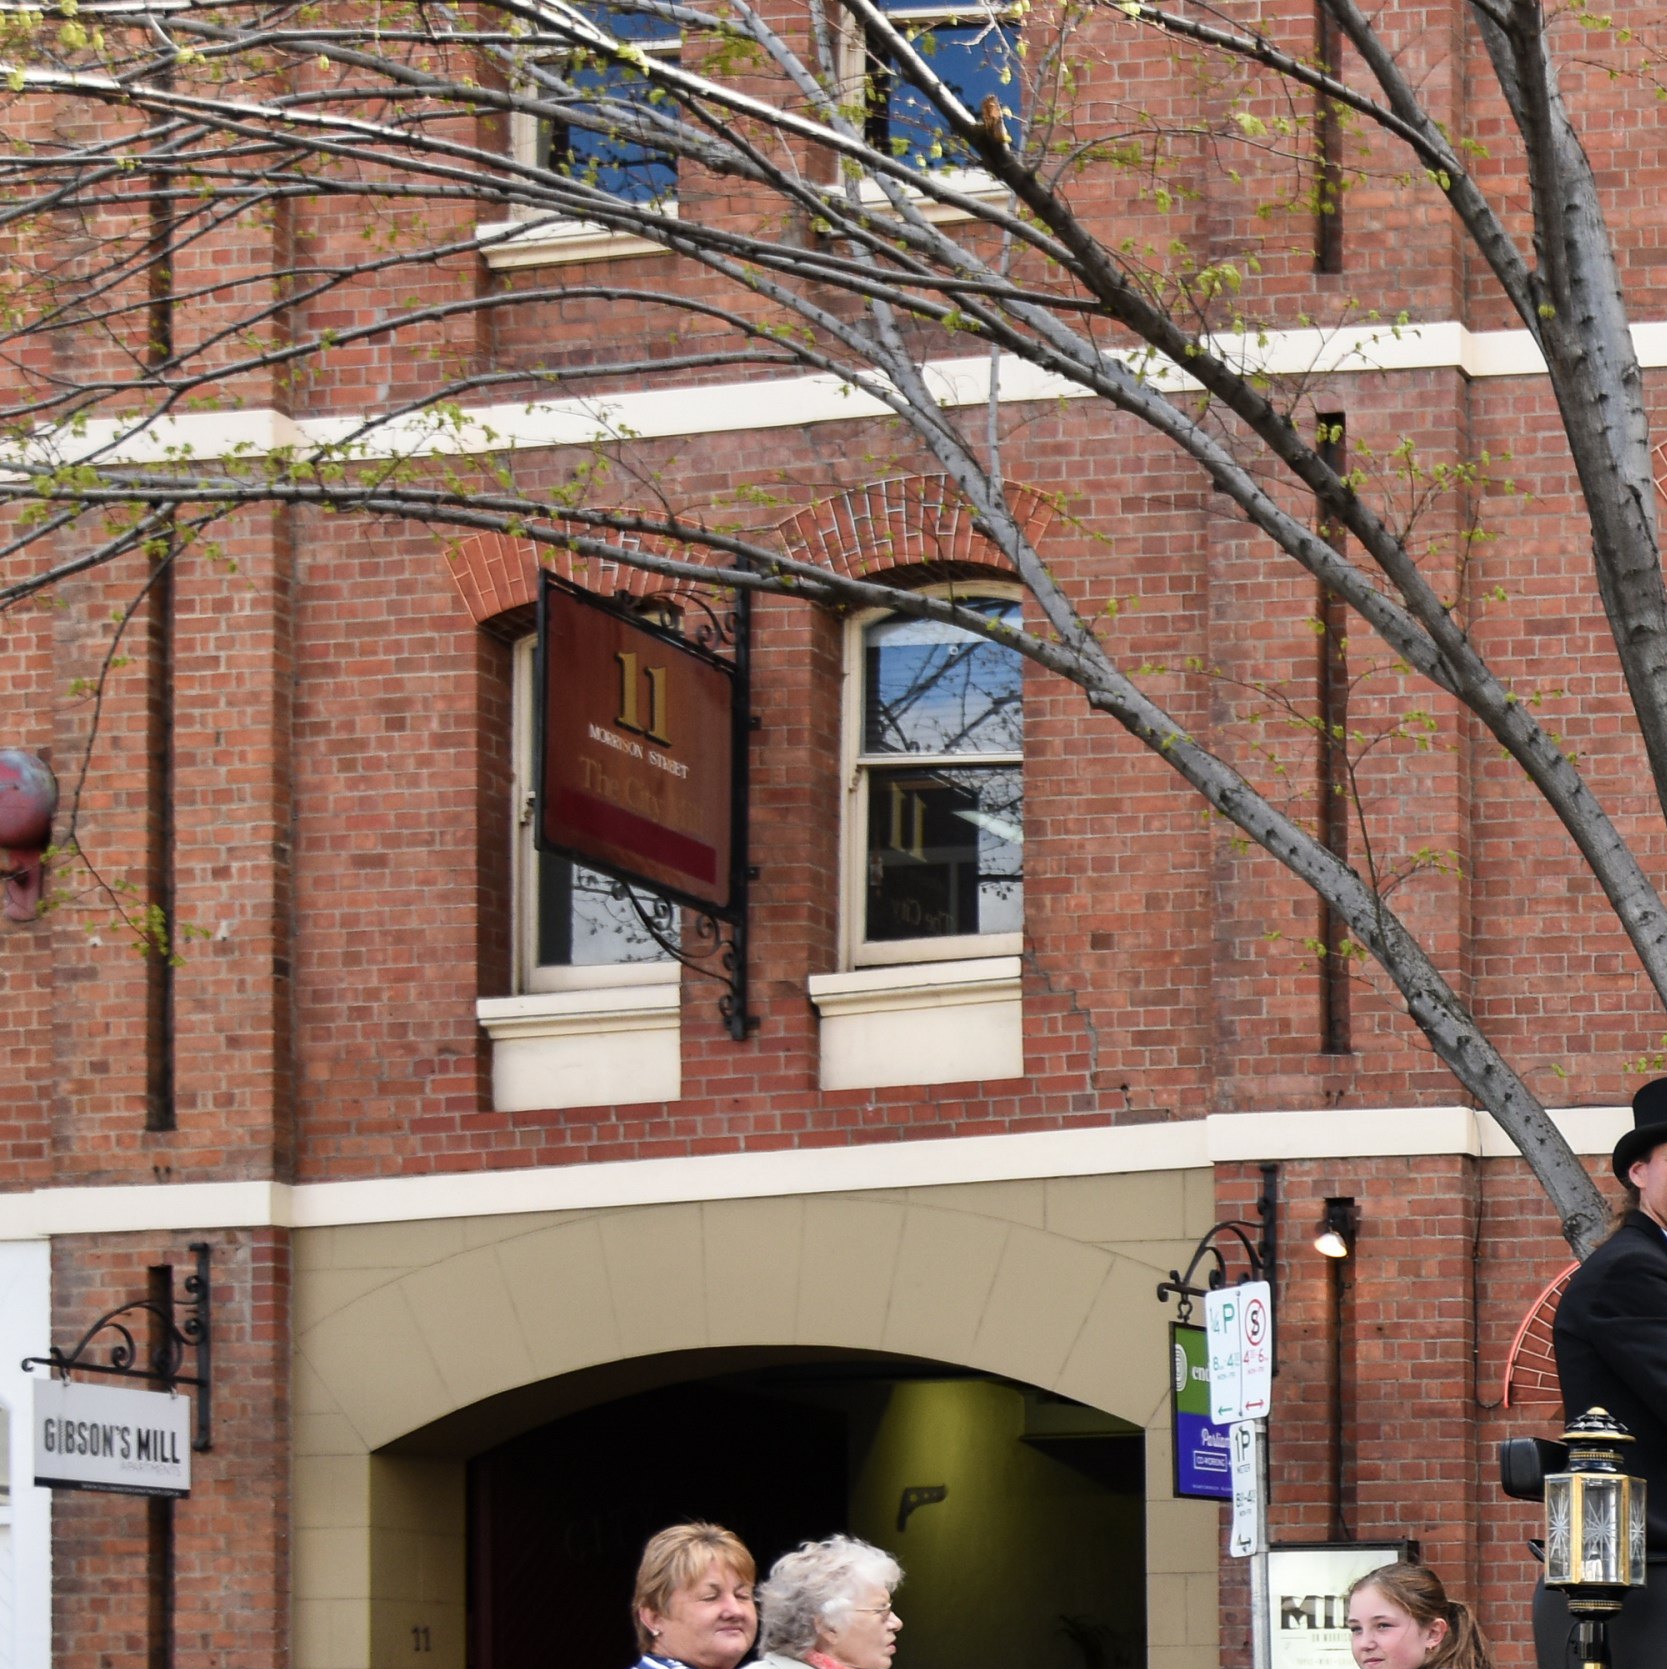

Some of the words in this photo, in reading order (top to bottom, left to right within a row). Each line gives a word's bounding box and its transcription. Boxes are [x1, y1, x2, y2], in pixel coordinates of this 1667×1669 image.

[614, 652, 673, 749] 11
[588, 722, 643, 759] MORRISON
[649, 750, 690, 779] STREET
[44, 1417, 131, 1460] GIBSON'S
[137, 1427, 181, 1464] MILL
[411, 1626, 432, 1652] 11
